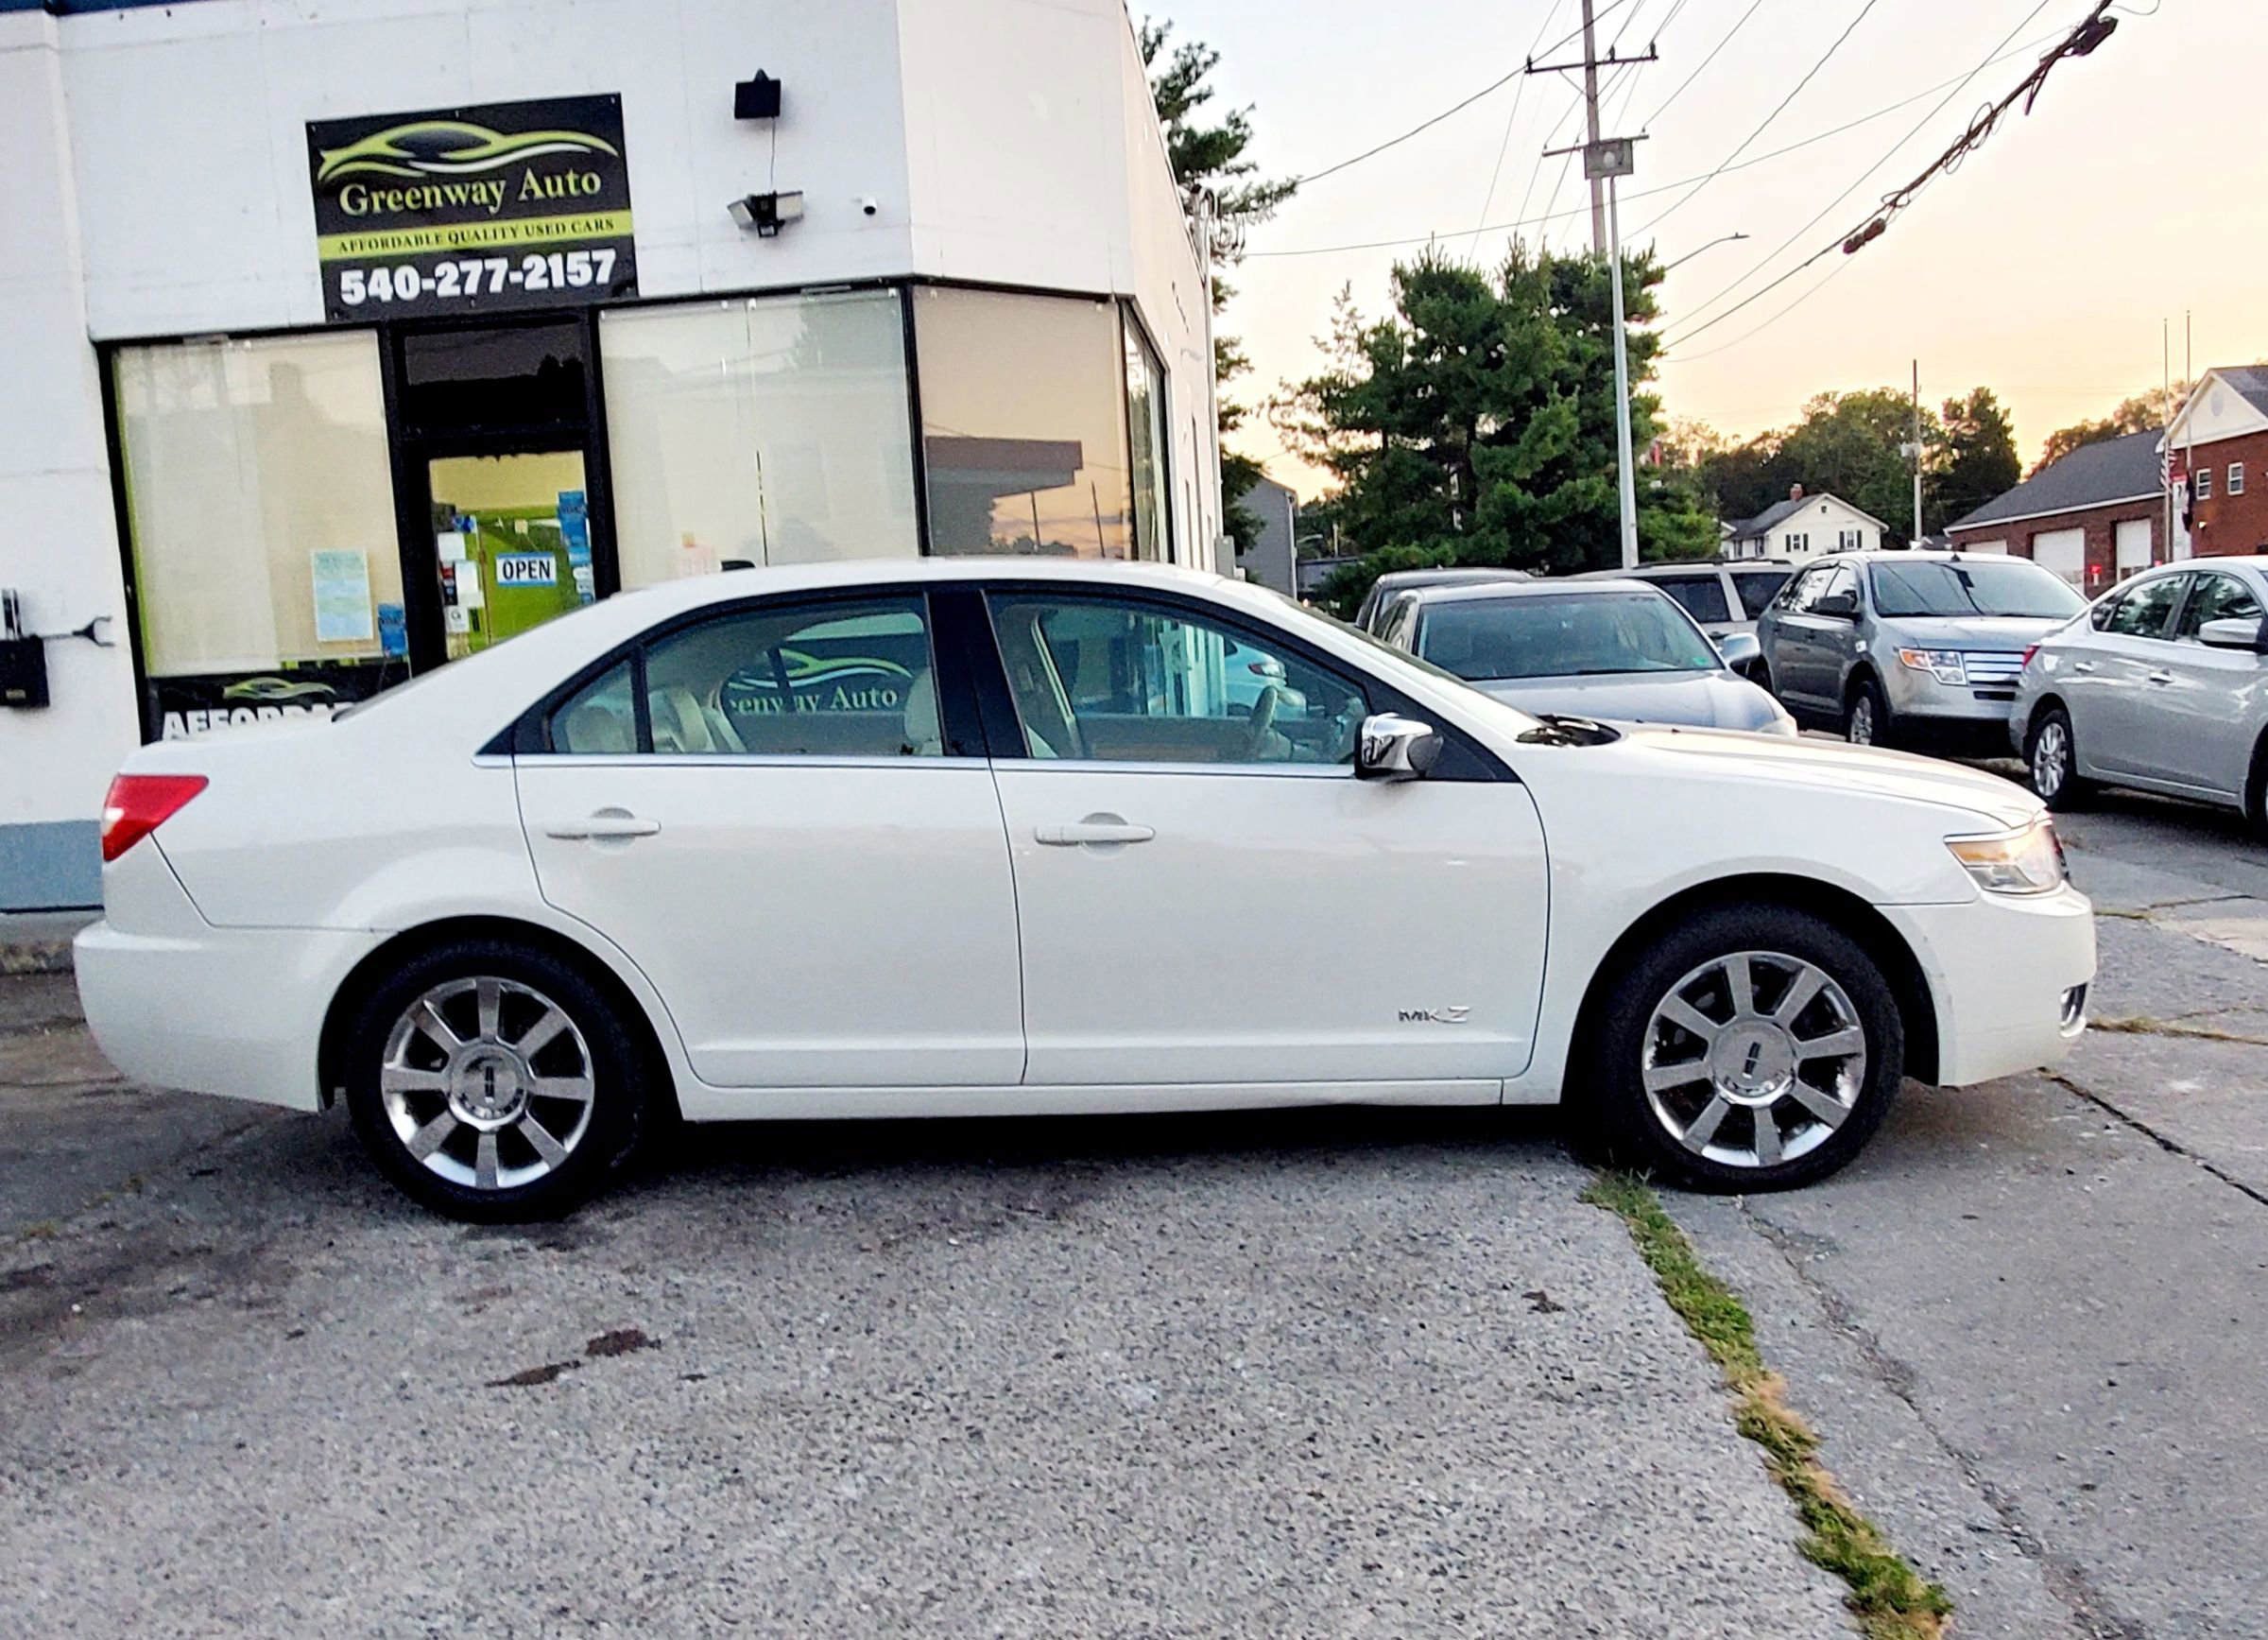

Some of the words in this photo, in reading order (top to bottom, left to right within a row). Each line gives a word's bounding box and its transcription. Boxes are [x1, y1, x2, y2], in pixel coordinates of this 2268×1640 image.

[339, 183, 507, 216] Greenway
[518, 167, 602, 201] Auto
[339, 232, 442, 253] AFFORDABLE
[448, 227, 518, 245] QUALITY
[524, 221, 566, 237] USED
[571, 217, 614, 233] CARS
[339, 248, 616, 305] 540-277-2157
[502, 559, 550, 580] OPEN
[830, 685, 898, 710] Auto
[1399, 1006, 1470, 1024] MKZ
